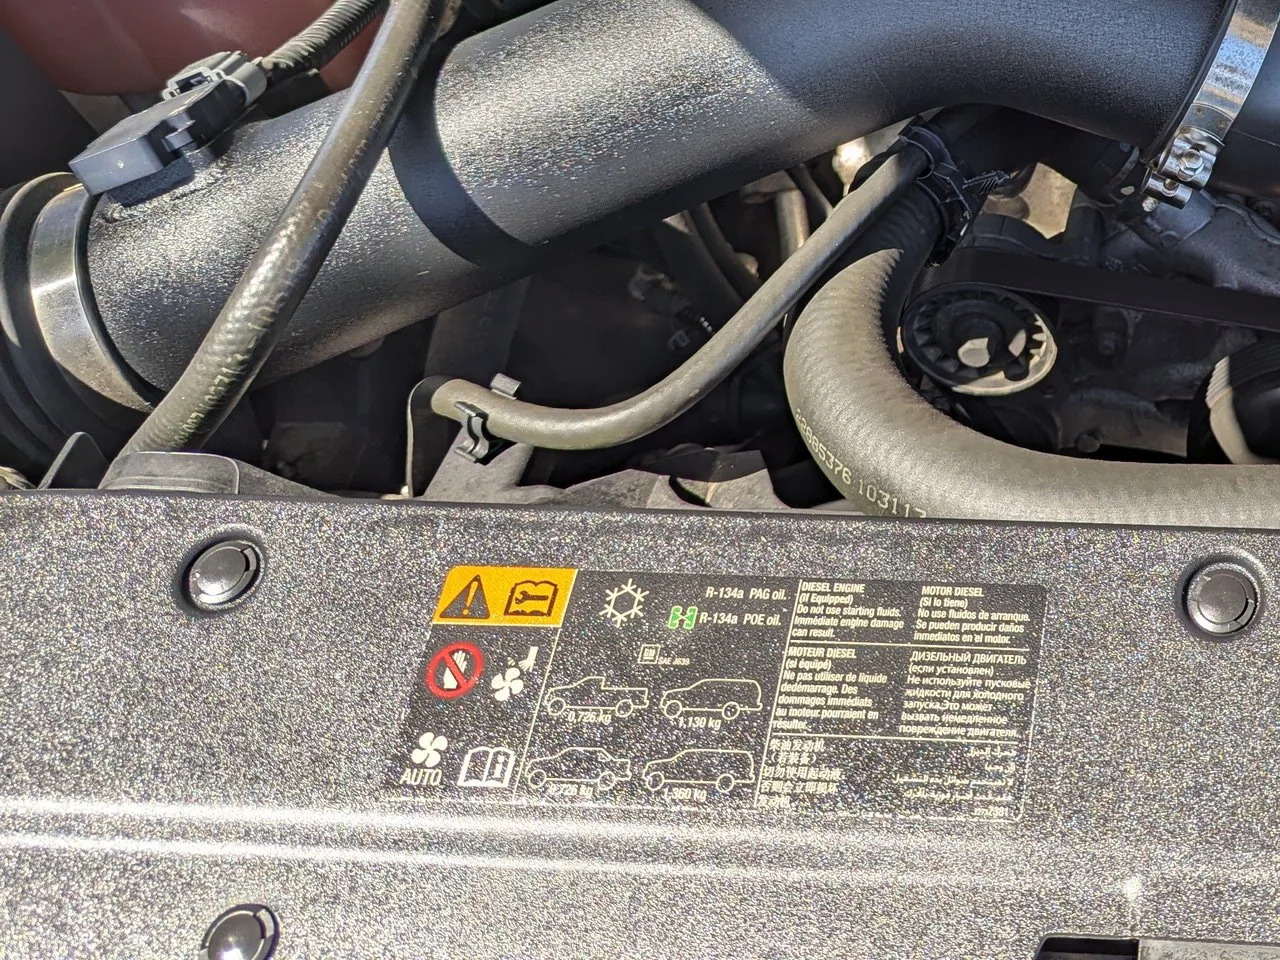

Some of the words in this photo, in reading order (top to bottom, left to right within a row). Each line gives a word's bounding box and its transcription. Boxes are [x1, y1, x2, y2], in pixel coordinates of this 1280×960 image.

[705, 586, 745, 599] R-134a
[748, 587, 771, 600] PAG
[771, 590, 787, 600] oil.
[801, 581, 832, 592] DIESEL
[833, 582, 866, 593] ENGINE
[921, 585, 953, 596] MOTOR
[953, 586, 985, 597] DIESEL
[810, 593, 854, 606] Equipped)
[943, 598, 969, 610] tiene)
[796, 604, 809, 614] Do
[810, 605, 825, 615] not
[825, 606, 842, 616] use
[842, 605, 875, 618] starting
[876, 606, 902, 617] fluids.
[917, 608, 930, 618] No
[931, 610, 947, 619] use
[948, 609, 977, 620] fluidos
[978, 610, 990, 621] de
[699, 611, 739, 624] R-134a
[742, 613, 766, 626] POE
[766, 614, 782, 626] oil.
[794, 615, 839, 627] Immediate
[840, 617, 869, 629] engine
[870, 618, 905, 630] damage
[915, 619, 927, 630] Se
[928, 620, 961, 632] pueden
[961, 621, 998, 633] producir
[998, 622, 1025, 633] daños
[791, 628, 808, 637] can
[808, 628, 836, 638] result.
[961, 633, 974, 642] en
[974, 633, 983, 643] el
[787, 646, 826, 657] MOTEUR
[826, 648, 858, 659] DIESEL
[910, 650, 972, 663] ДИЗЕЛЬНЫЙ
[971, 652, 1028, 665] ДВИГАТЕЛЬ
[783, 670, 796, 680] Ne
[796, 671, 814, 682] pas
[814, 671, 845, 682] utiliser
[845, 672, 858, 683] de
[858, 672, 888, 684] liquide
[906, 674, 922, 685] Не
[841, 683, 858, 695] Des
[777, 693, 827, 707] dommages
[827, 695, 873, 708] immédiats
[775, 708, 788, 717] au
[821, 708, 867, 720] pourraient
[867, 710, 880, 720] en
[708, 716, 722, 731] kg
[400, 768, 443, 787] AUTO
